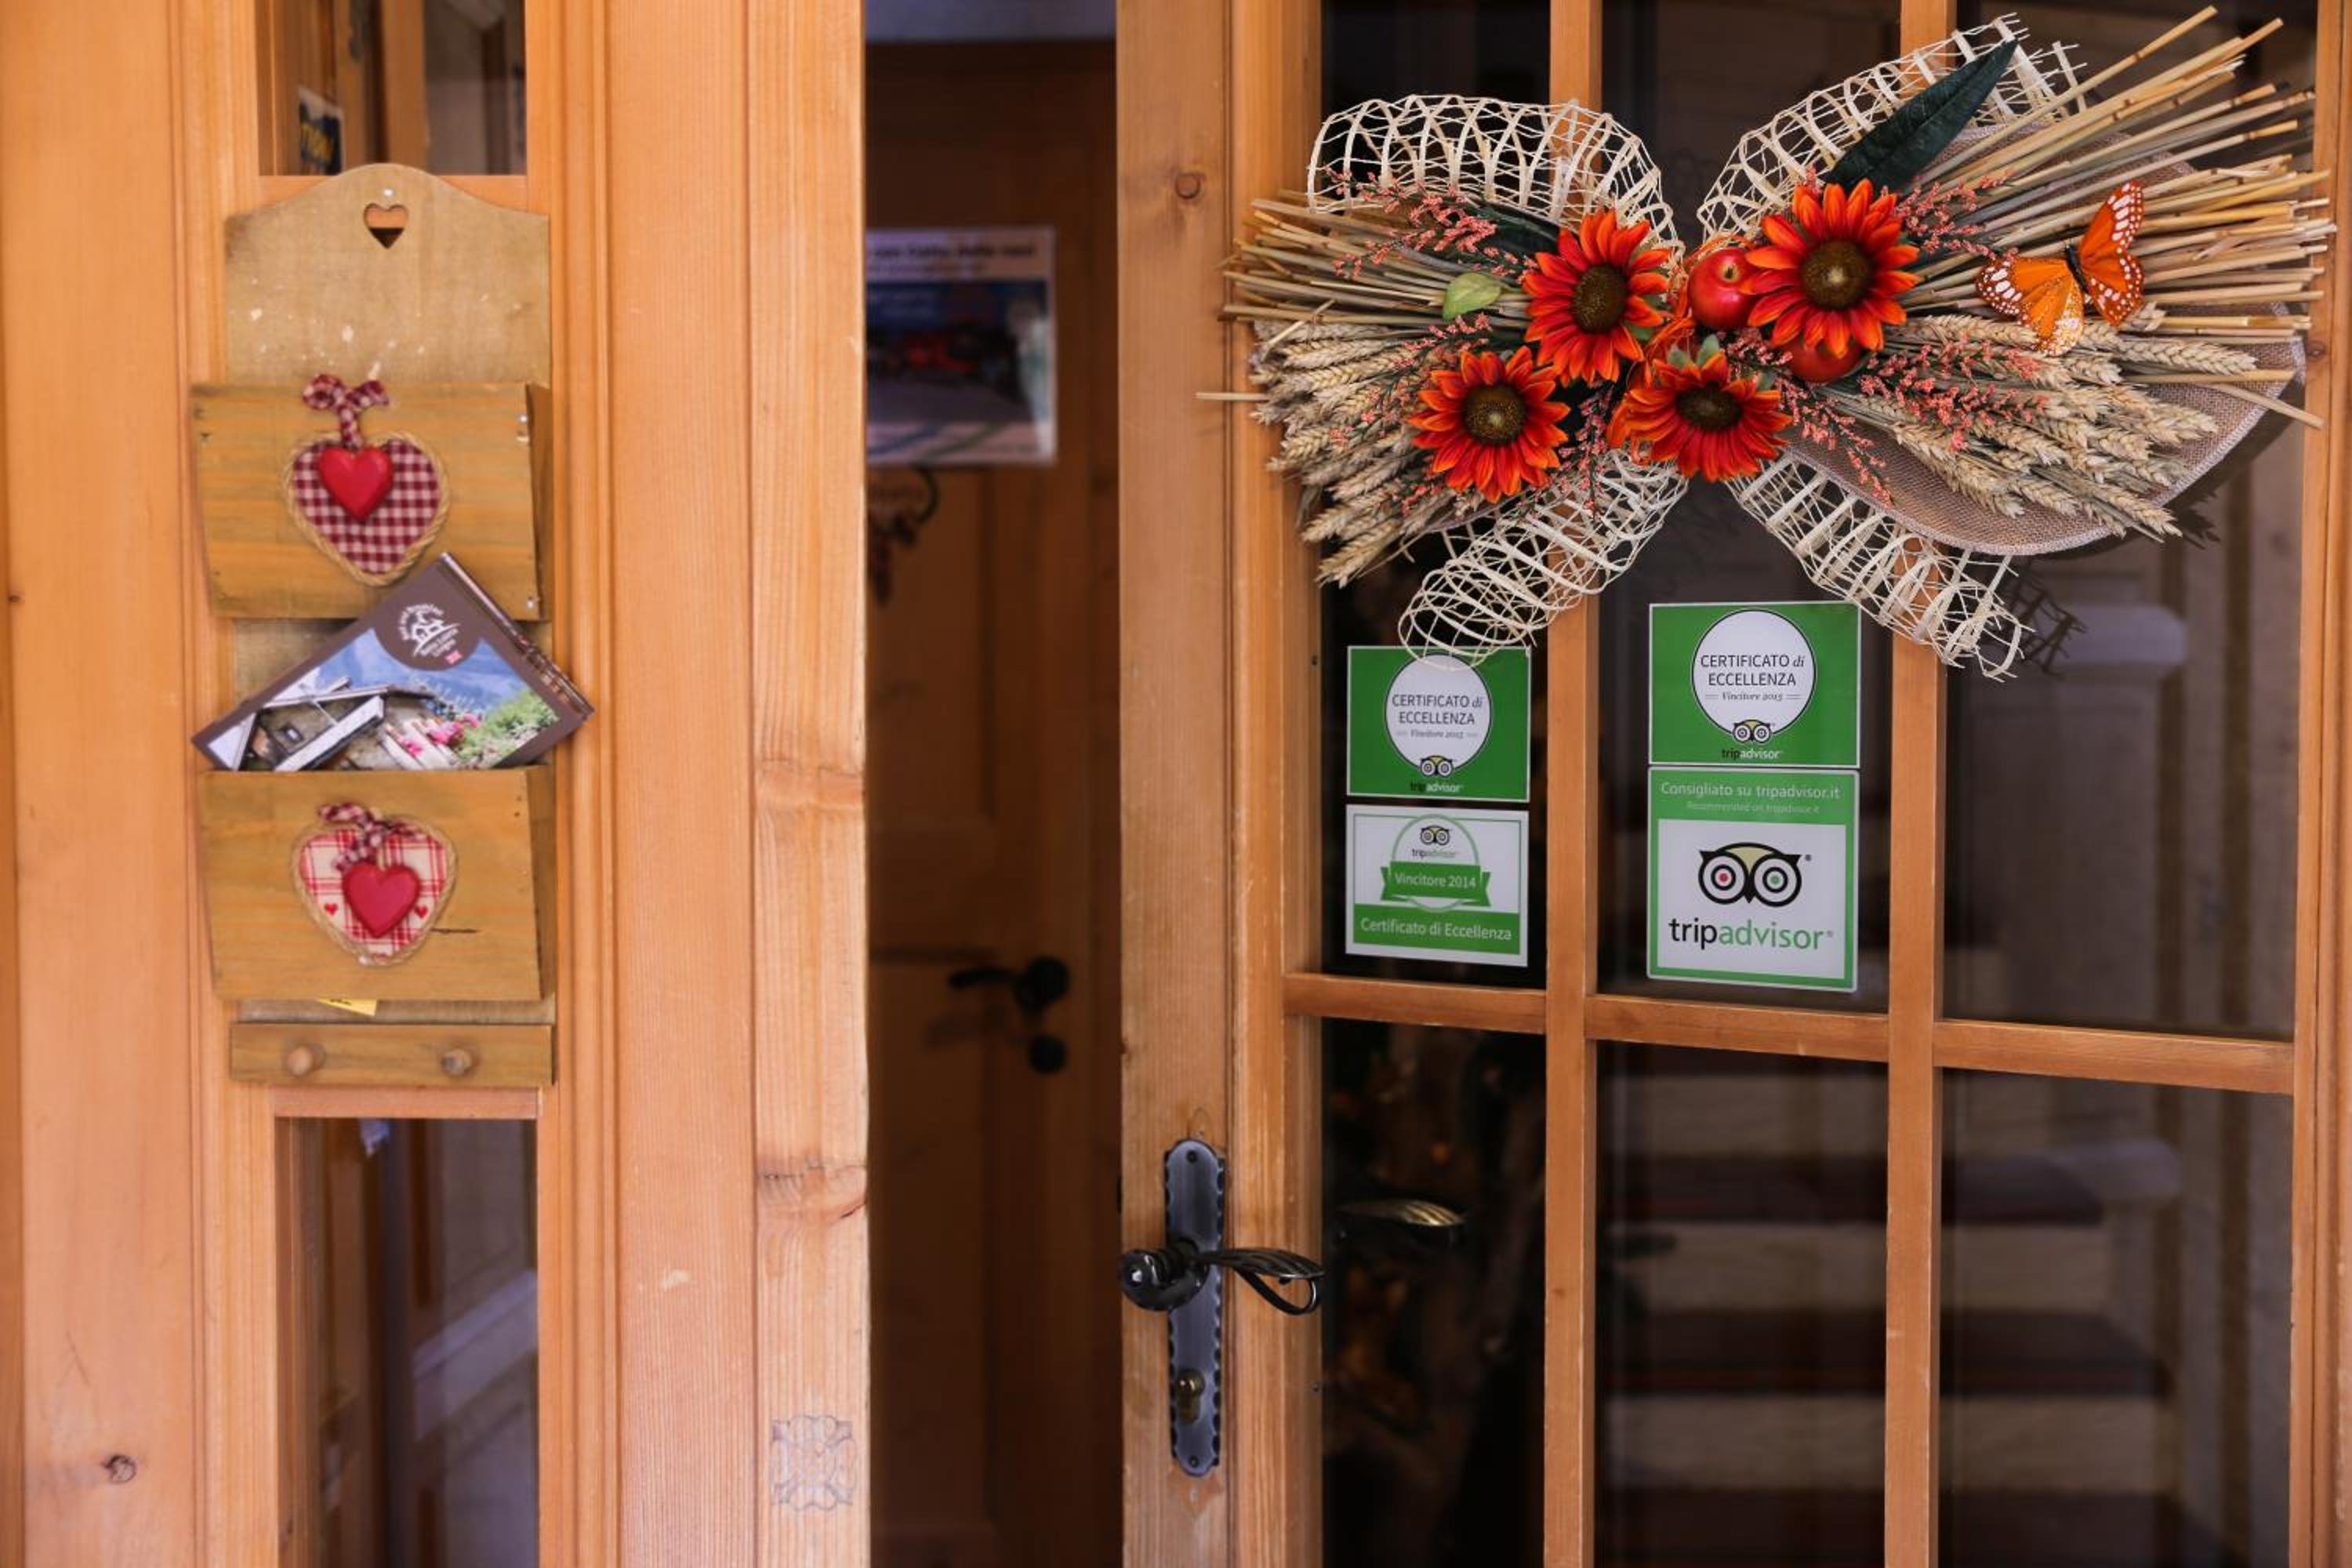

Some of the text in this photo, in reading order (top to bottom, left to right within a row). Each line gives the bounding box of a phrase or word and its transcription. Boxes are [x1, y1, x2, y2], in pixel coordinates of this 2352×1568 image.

[1700, 655, 1805, 667] CERTIFICATO di
[1708, 672, 1796, 686] ECCELLENZA
[1392, 694, 1483, 708] CERTIFICATO di
[1722, 691, 1761, 701] Vincitore
[1399, 711, 1475, 725] ECCELLENZA
[1722, 748, 1780, 760] tripadvisor
[1410, 781, 1461, 793] tripadvisor
[1661, 782, 1841, 799] Consigliato su tripadvisor.it
[1395, 872, 1476, 889] Vincitore 2014
[1360, 917, 1512, 940] Certificato di Eccellenza
[1668, 917, 1824, 949] tripadvisor
